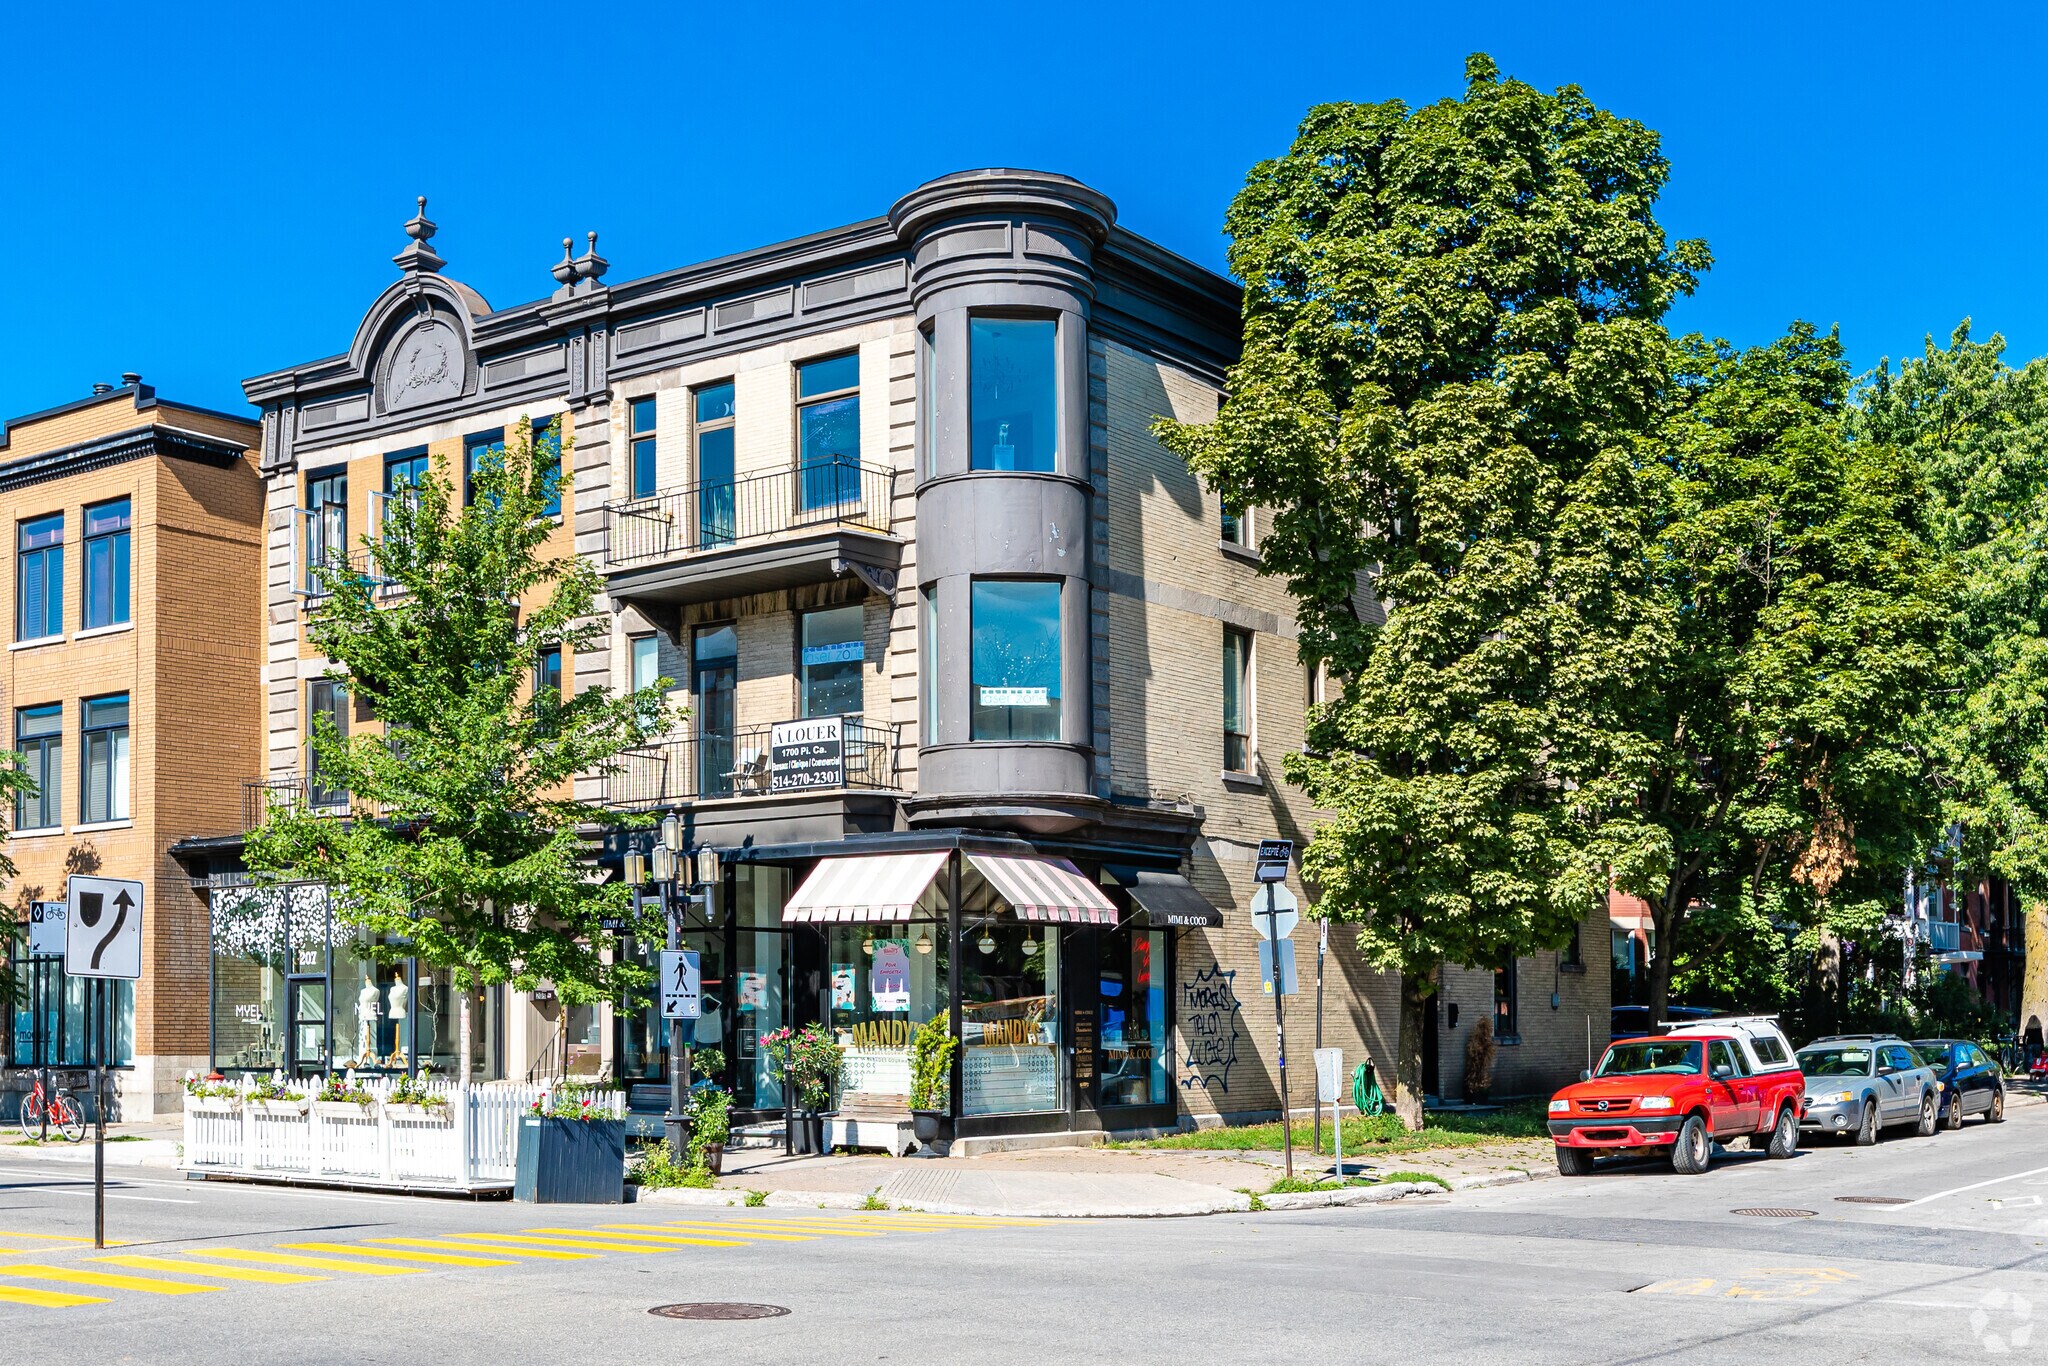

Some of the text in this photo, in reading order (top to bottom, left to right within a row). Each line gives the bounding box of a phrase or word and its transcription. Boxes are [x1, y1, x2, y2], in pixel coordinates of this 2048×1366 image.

[787, 725, 837, 743] LOUER
[782, 748, 799, 757] 1700
[812, 745, 827, 754] Ca.
[773, 770, 840, 788] 514-270-2301
[1167, 914, 1208, 926] MIMI & COCO
[299, 951, 317, 965] 207
